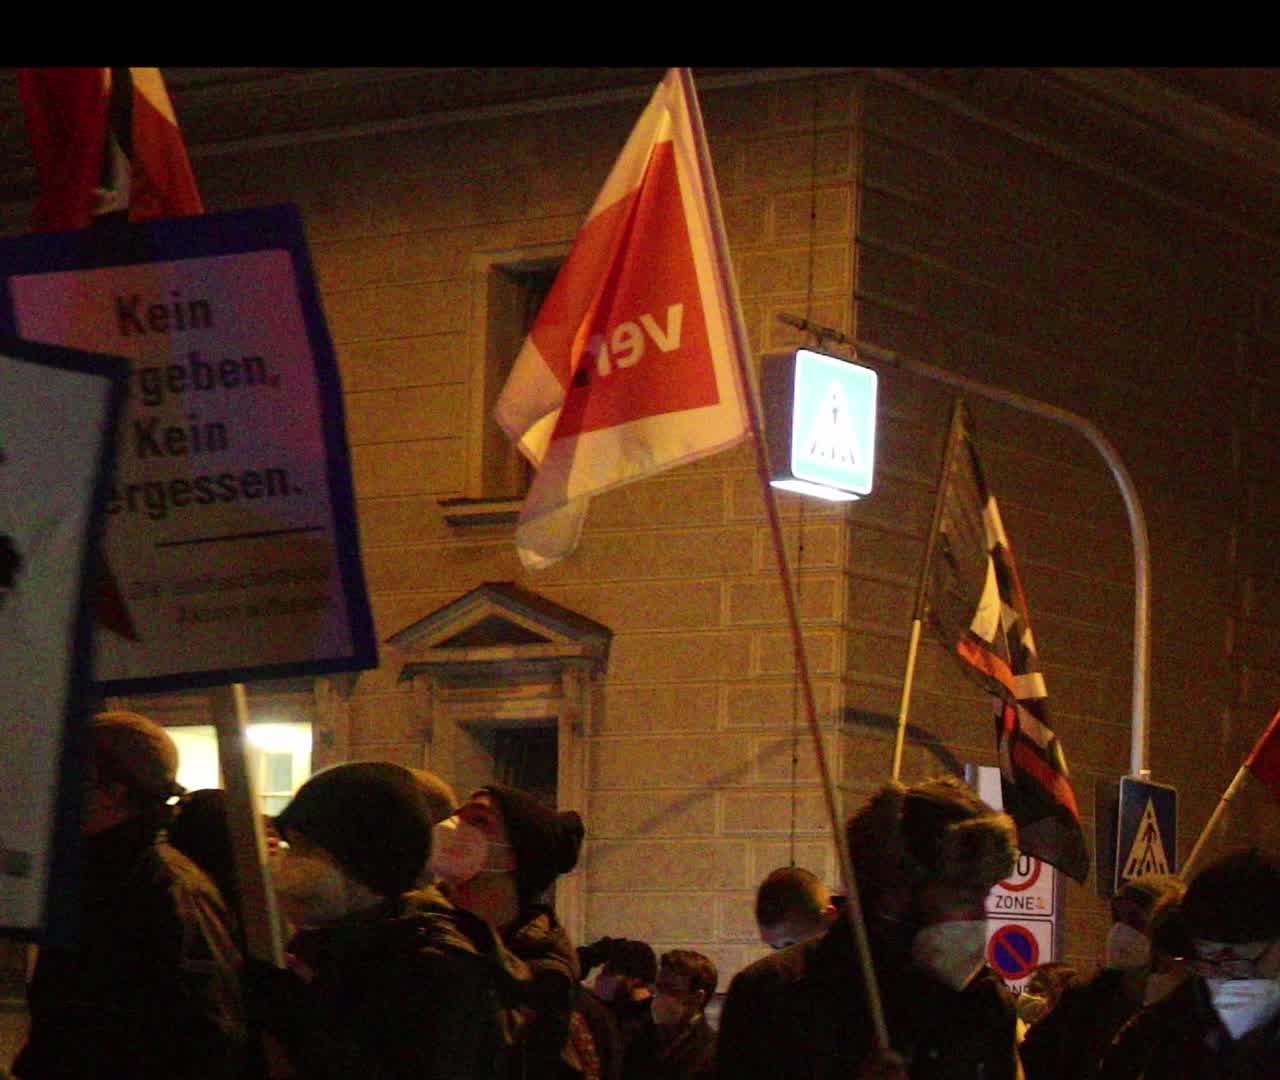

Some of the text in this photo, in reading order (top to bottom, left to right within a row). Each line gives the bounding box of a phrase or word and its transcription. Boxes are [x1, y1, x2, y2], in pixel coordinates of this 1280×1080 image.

[114, 290, 213, 337] Kein
[129, 351, 281, 406] geben.
[133, 413, 229, 459] Kein
[104, 467, 303, 520] ergessen.
[995, 895, 1035, 911] ZONE
